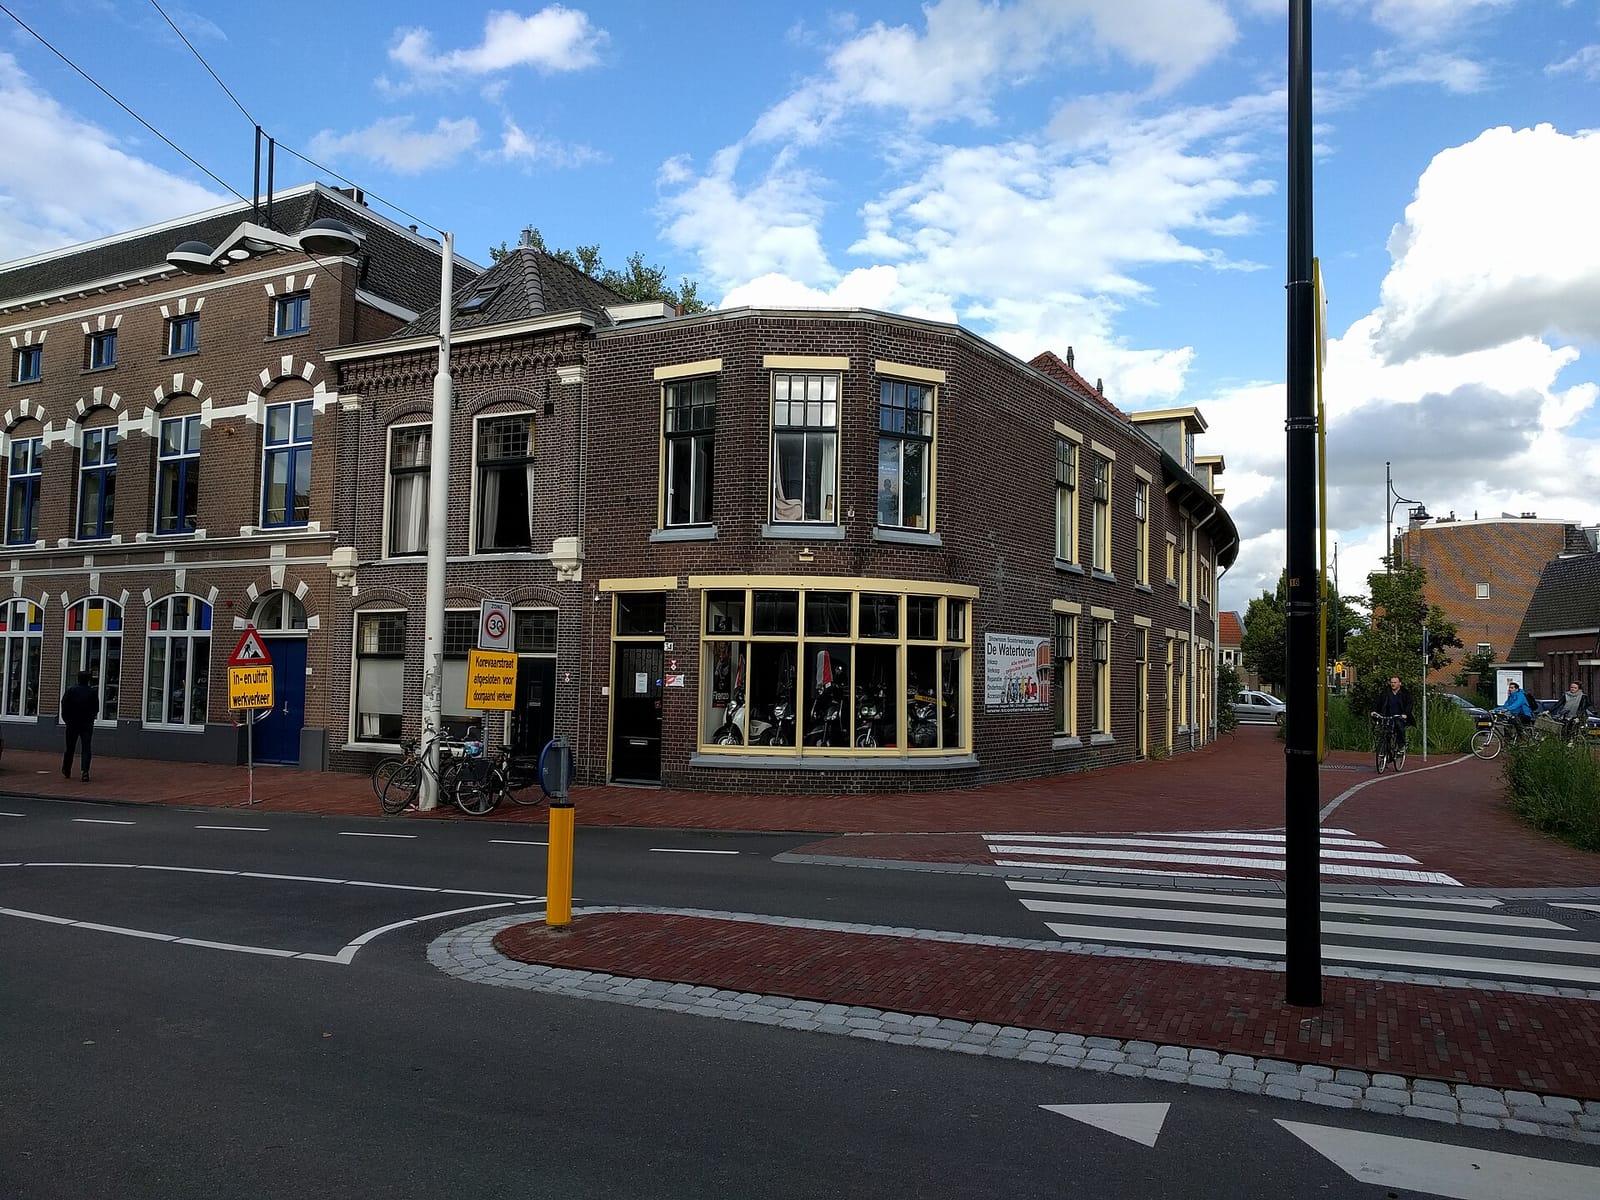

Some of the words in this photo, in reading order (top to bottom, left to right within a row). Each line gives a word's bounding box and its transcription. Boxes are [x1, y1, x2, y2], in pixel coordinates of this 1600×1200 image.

[489, 619, 503, 632] 30
[987, 642, 996, 656] De
[998, 643, 1036, 657] Watertoren
[475, 655, 514, 669] Korevaarstraat
[252, 670, 268, 683] uitrit
[473, 673, 500, 687] afgesloten
[502, 676, 514, 685] voor
[232, 692, 270, 706] werkverkeer
[473, 690, 496, 704] doorgaand
[496, 691, 513, 702] verkeer
